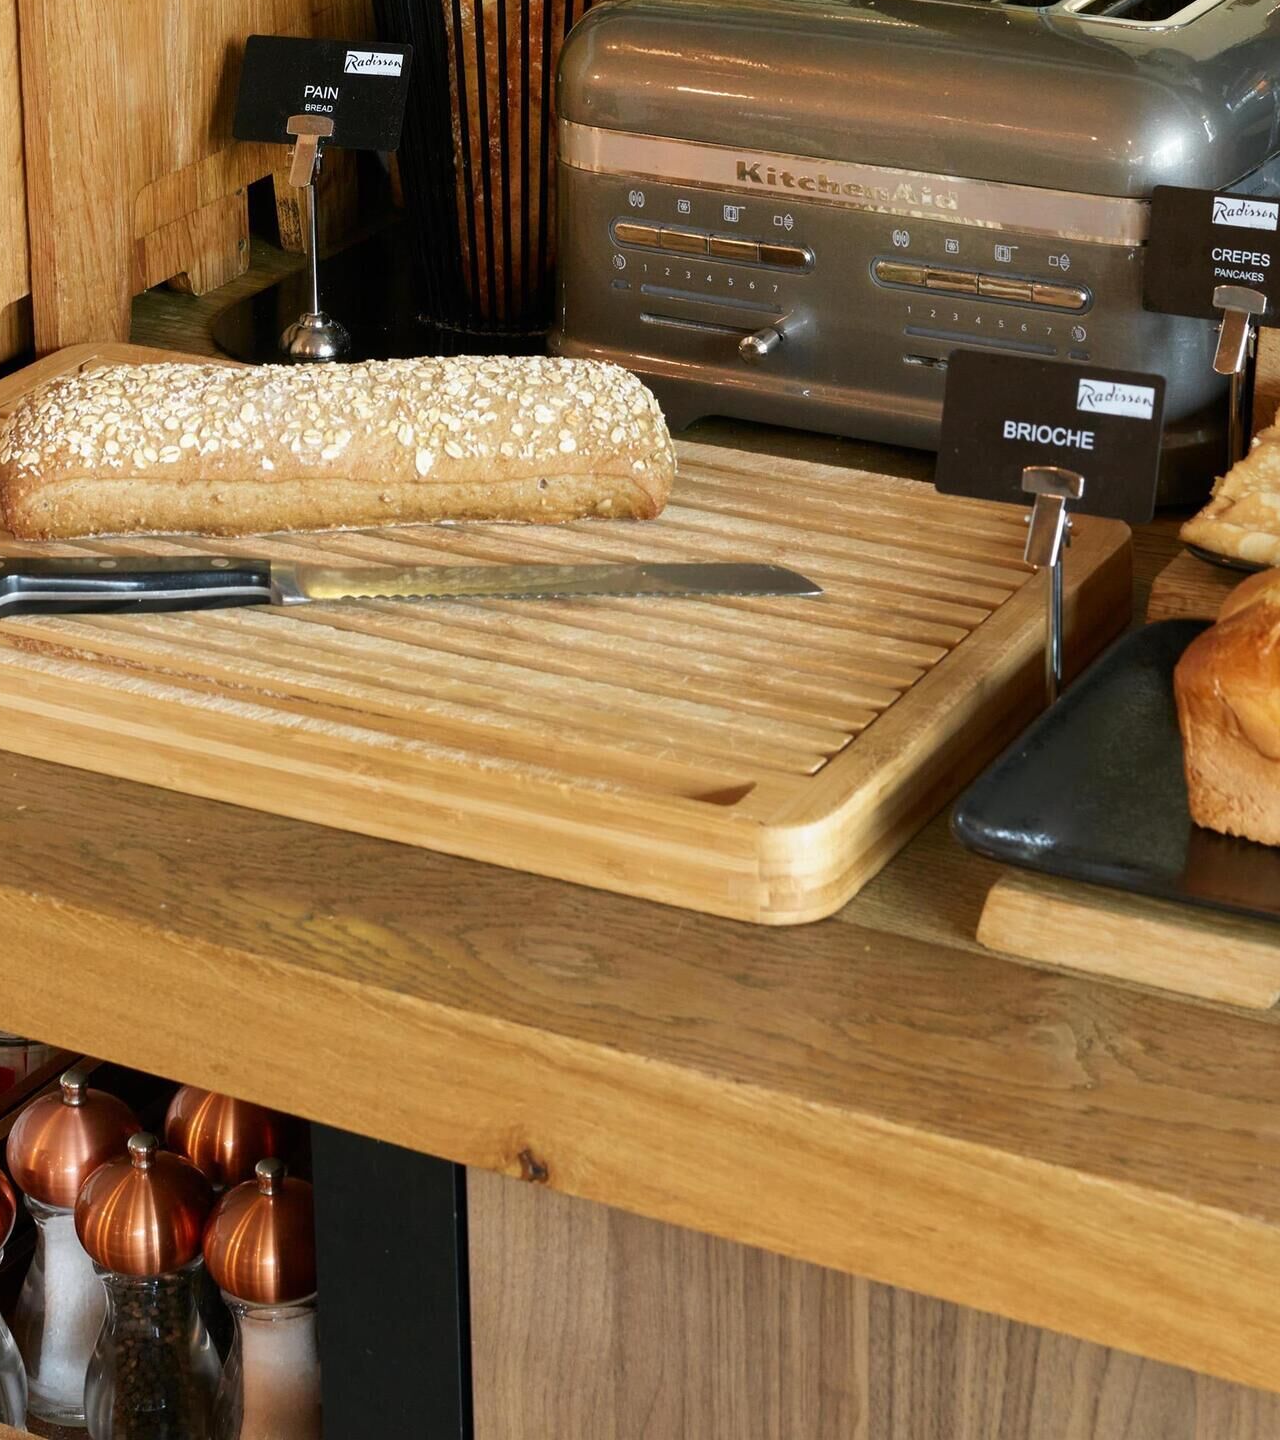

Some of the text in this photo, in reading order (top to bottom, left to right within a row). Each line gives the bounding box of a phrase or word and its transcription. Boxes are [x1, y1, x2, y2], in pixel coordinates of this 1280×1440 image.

[345, 53, 402, 72] Radisson
[304, 85, 339, 100] PAIN
[305, 104, 333, 113] BREAD
[735, 160, 959, 210] KitchenAid
[1213, 201, 1278, 223] Radisson
[1211, 247, 1271, 267] CREPES
[1214, 268, 1265, 282] PANCAKES
[1078, 384, 1154, 408] Radisson
[1003, 420, 1095, 450] BRIOCHE
